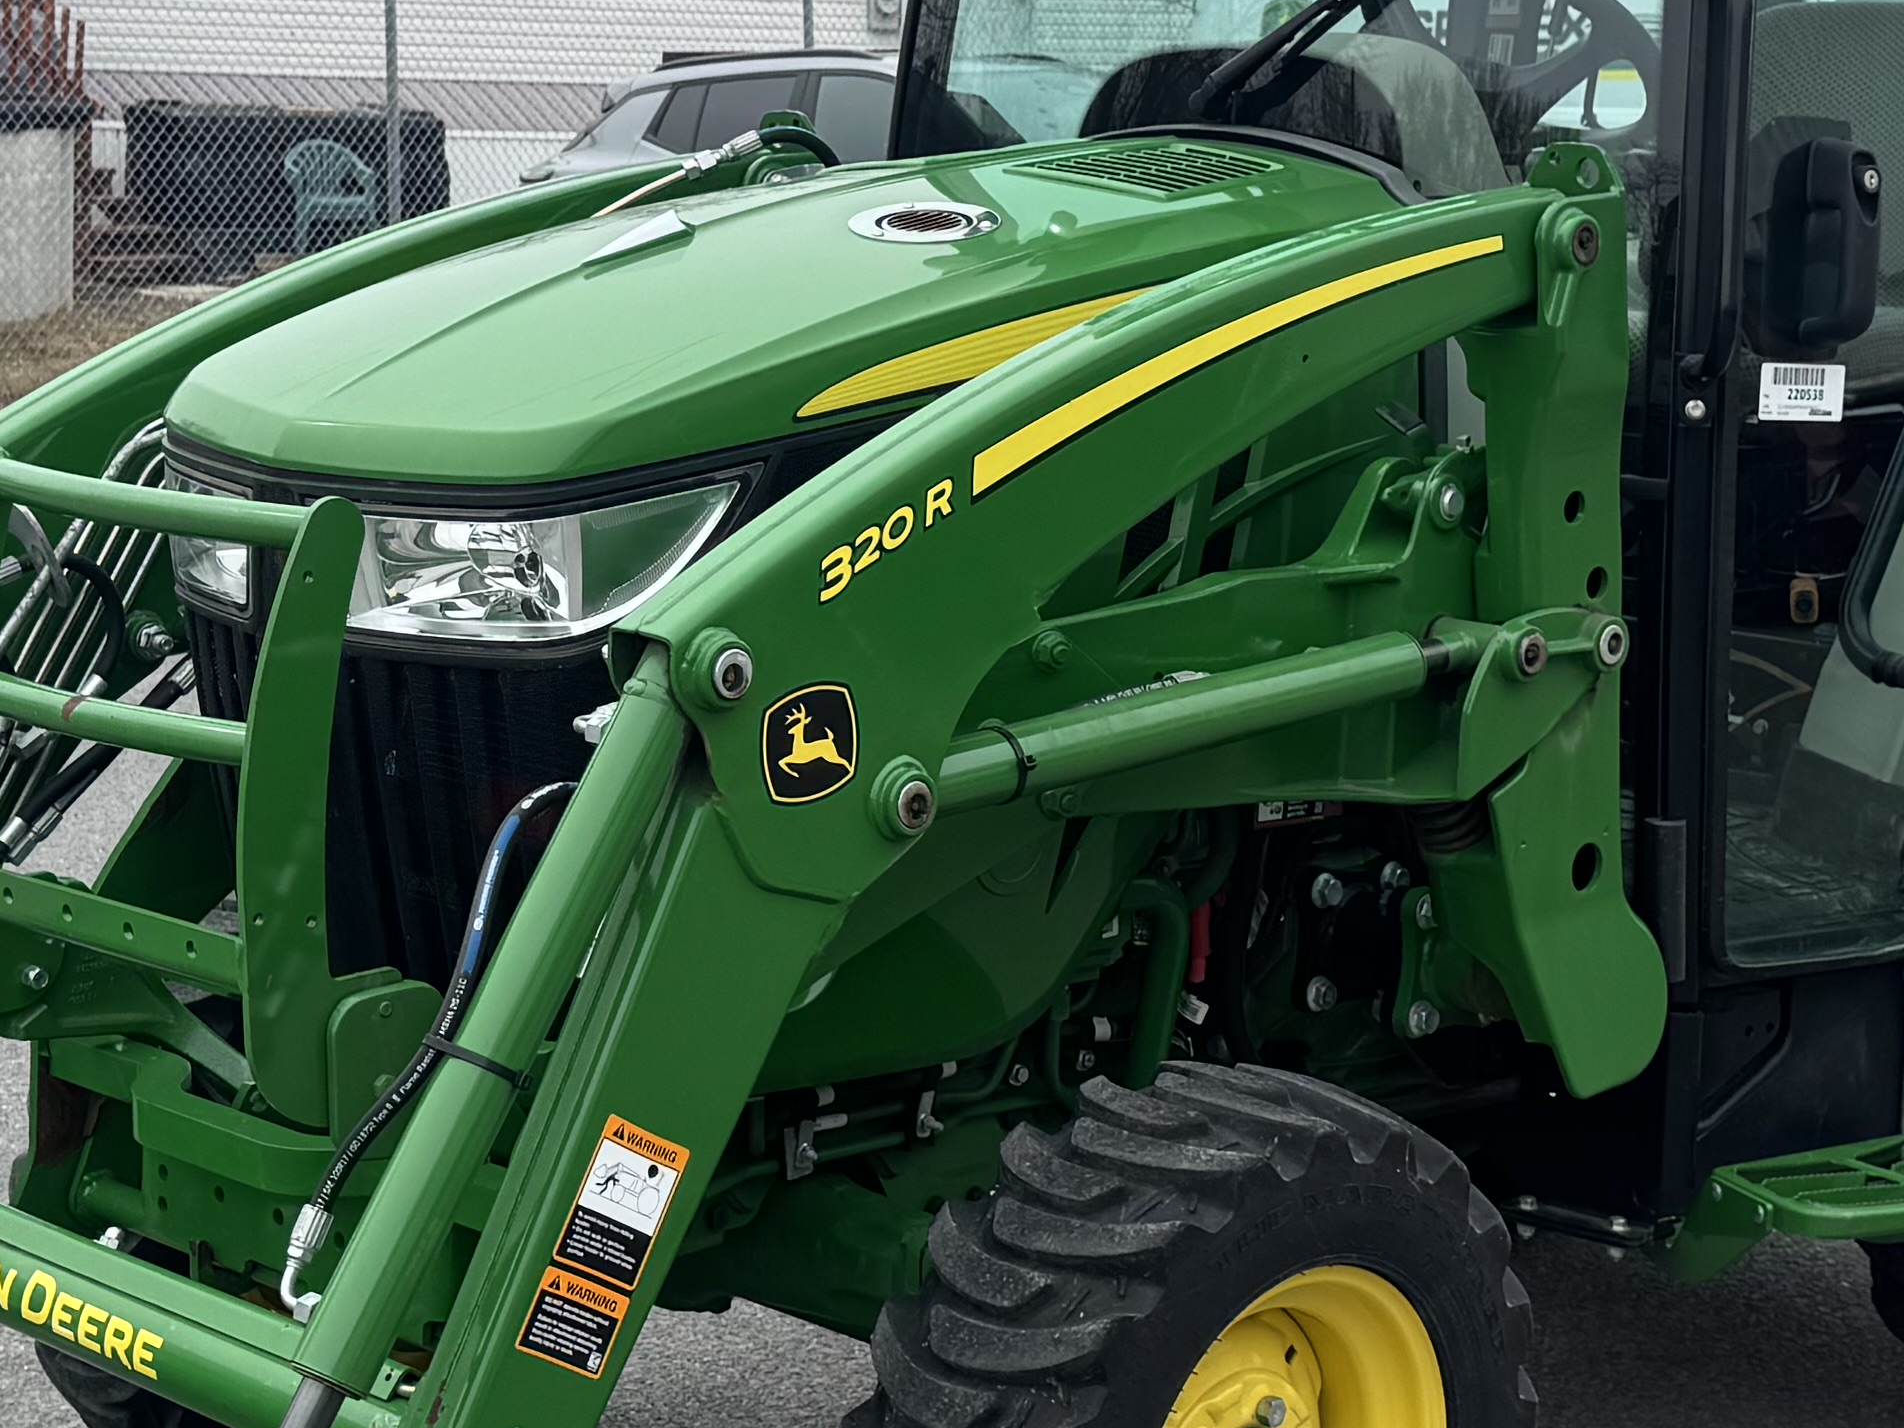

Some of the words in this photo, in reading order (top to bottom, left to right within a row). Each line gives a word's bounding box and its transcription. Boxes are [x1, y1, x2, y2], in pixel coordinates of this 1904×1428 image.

[1788, 388, 1824, 400] 220538
[819, 505, 915, 603] 320
[925, 478, 954, 528] R
[399, 1072, 421, 1095] Flame
[626, 1131, 678, 1164] WARNING
[565, 1280, 618, 1314] WARNING
[21, 1269, 165, 1381] DEERE
